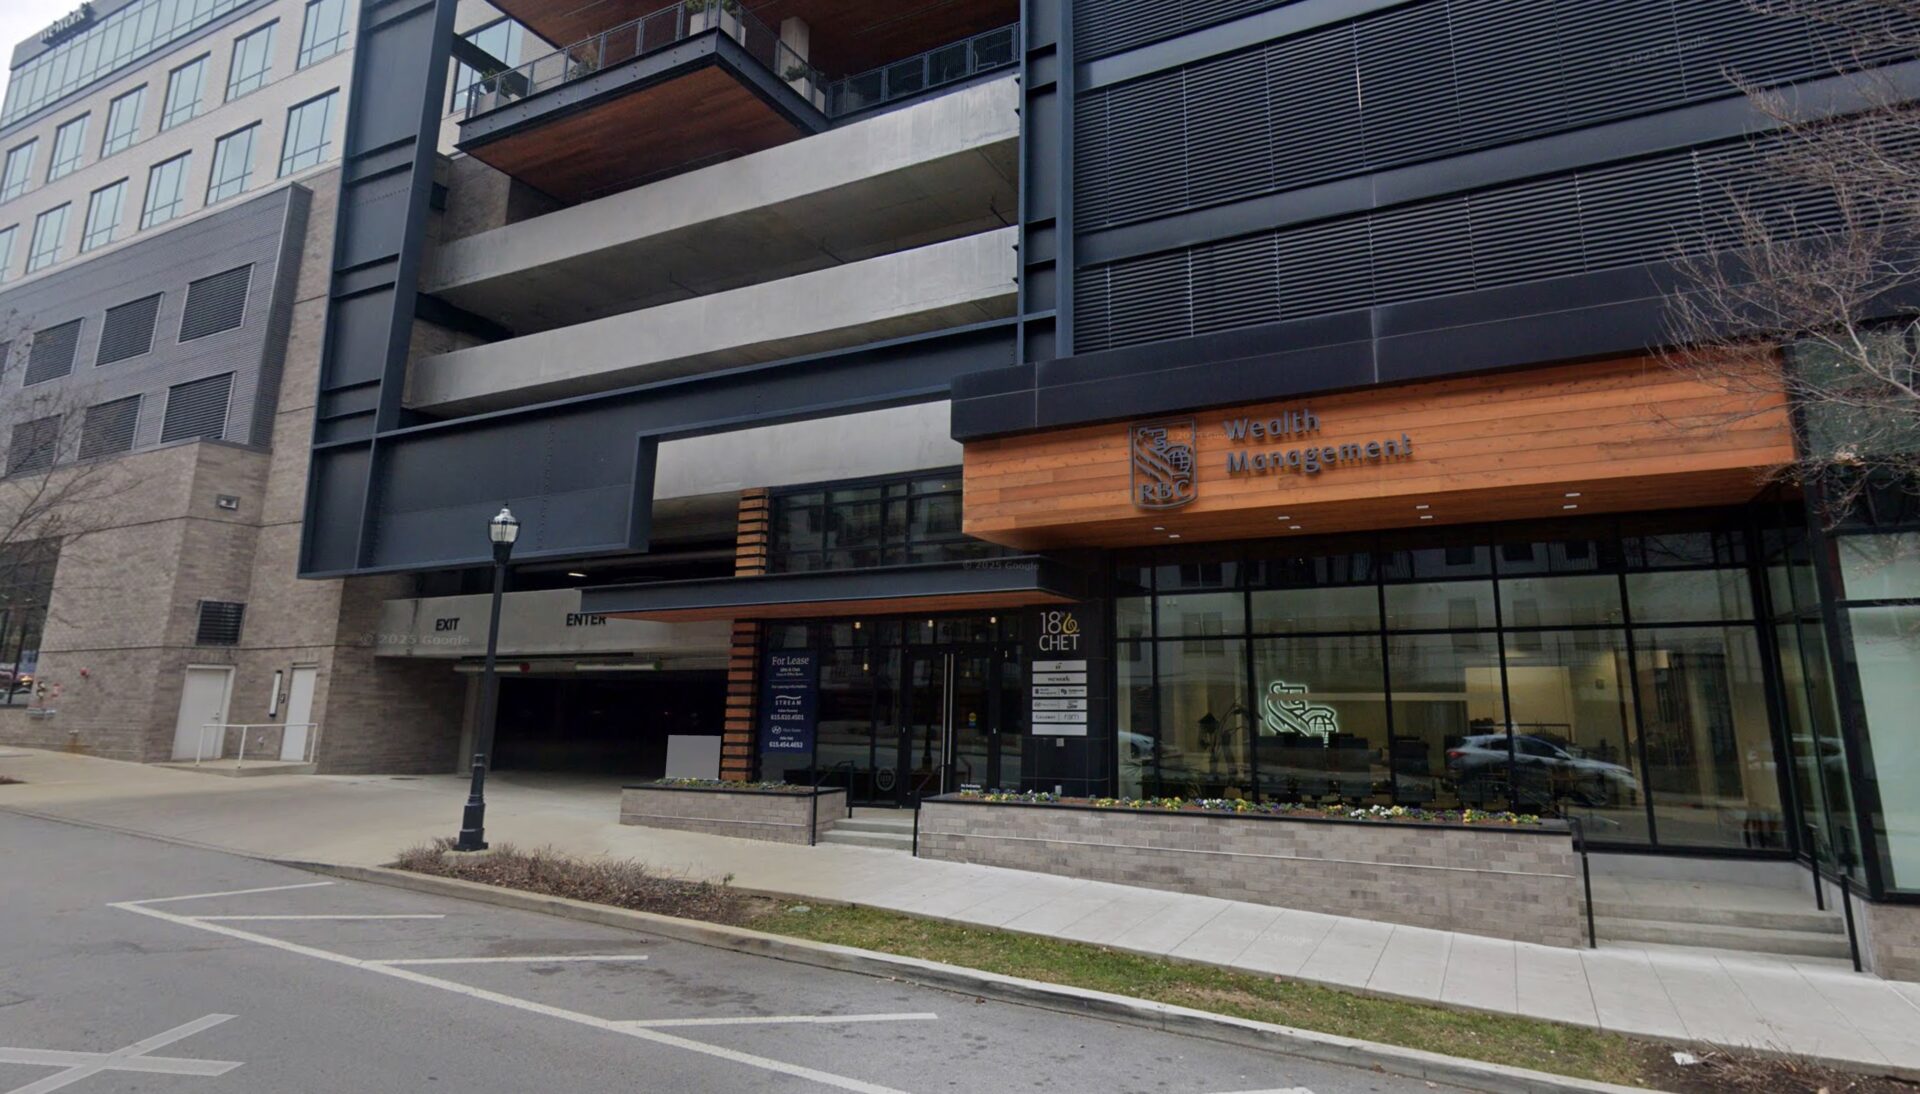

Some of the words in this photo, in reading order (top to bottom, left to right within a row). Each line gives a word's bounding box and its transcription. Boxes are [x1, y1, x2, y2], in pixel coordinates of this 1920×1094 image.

[1223, 408, 1321, 441] Wealth
[1226, 433, 1413, 475] Management
[1137, 480, 1190, 504] RBC
[435, 617, 461, 632] EXIT
[566, 612, 608, 626] ENTER
[1039, 634, 1080, 651] CHET
[771, 656, 785, 667] For
[787, 656, 810, 666] Lease
